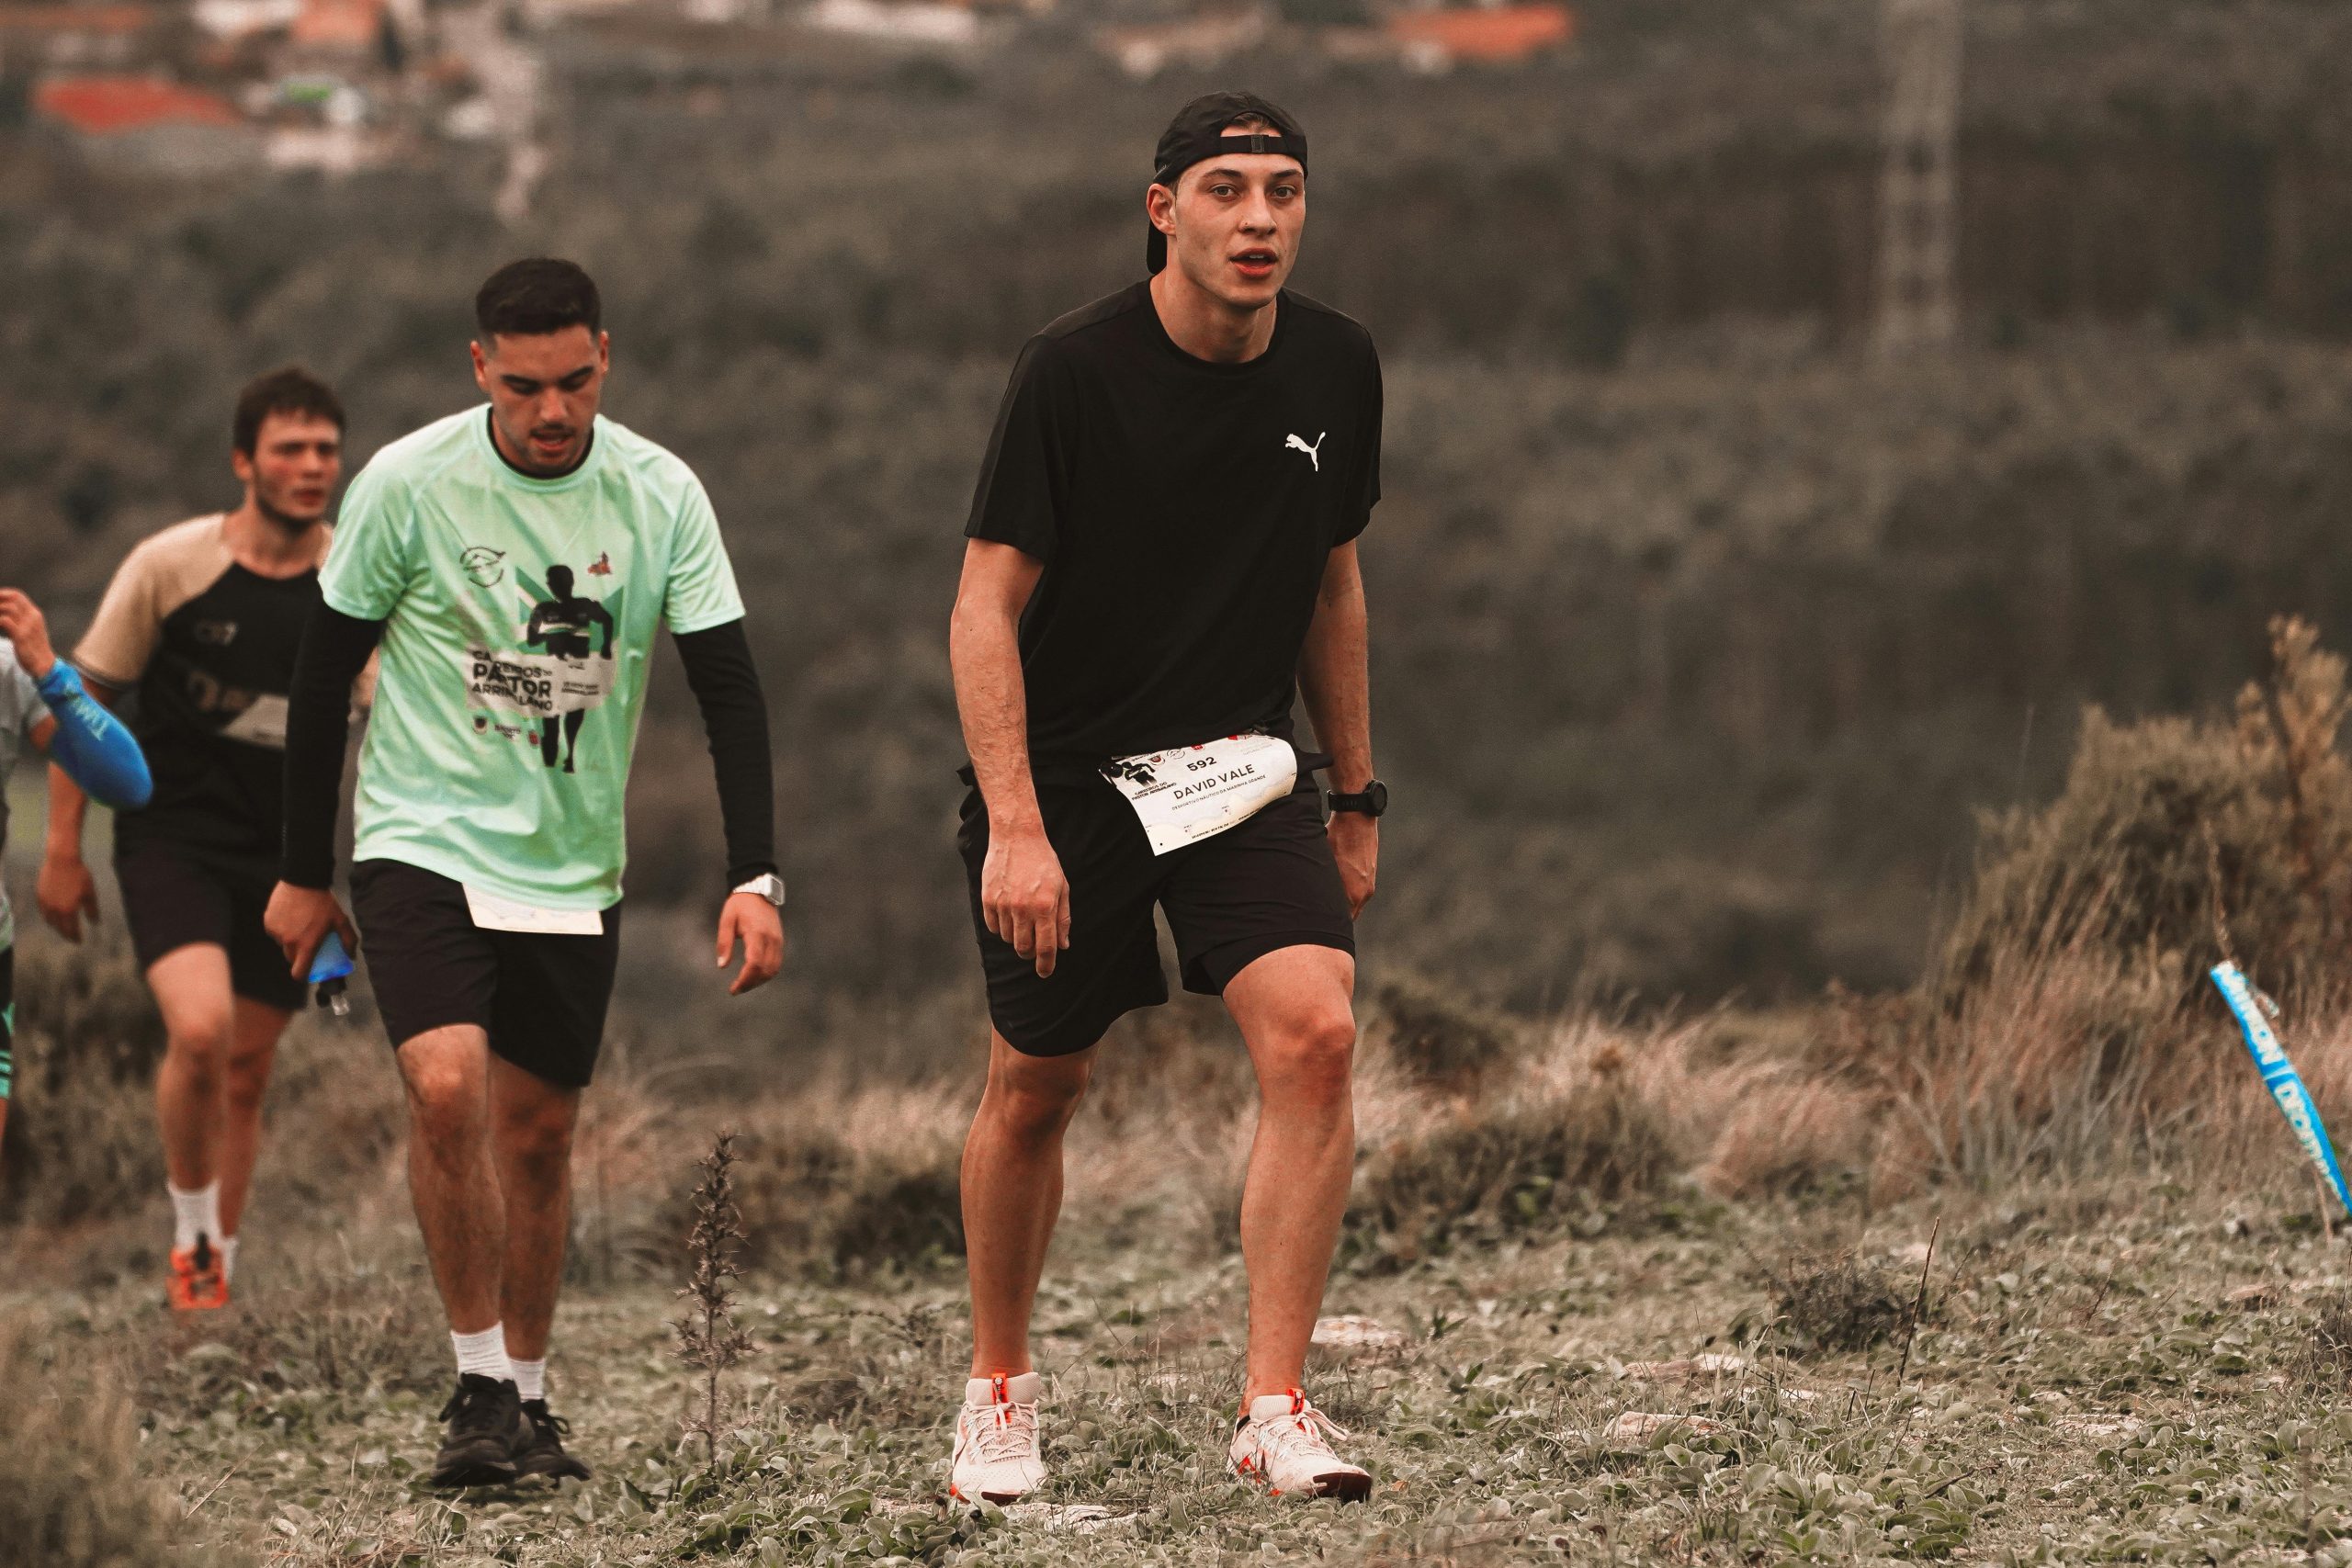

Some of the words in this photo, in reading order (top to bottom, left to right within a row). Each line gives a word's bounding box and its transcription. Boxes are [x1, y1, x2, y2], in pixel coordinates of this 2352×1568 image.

[472, 662, 551, 698] PATOR
[1173, 778, 1216, 800] DAVID
[1217, 763, 1255, 784] VALE
[1186, 756, 1217, 772] 592
